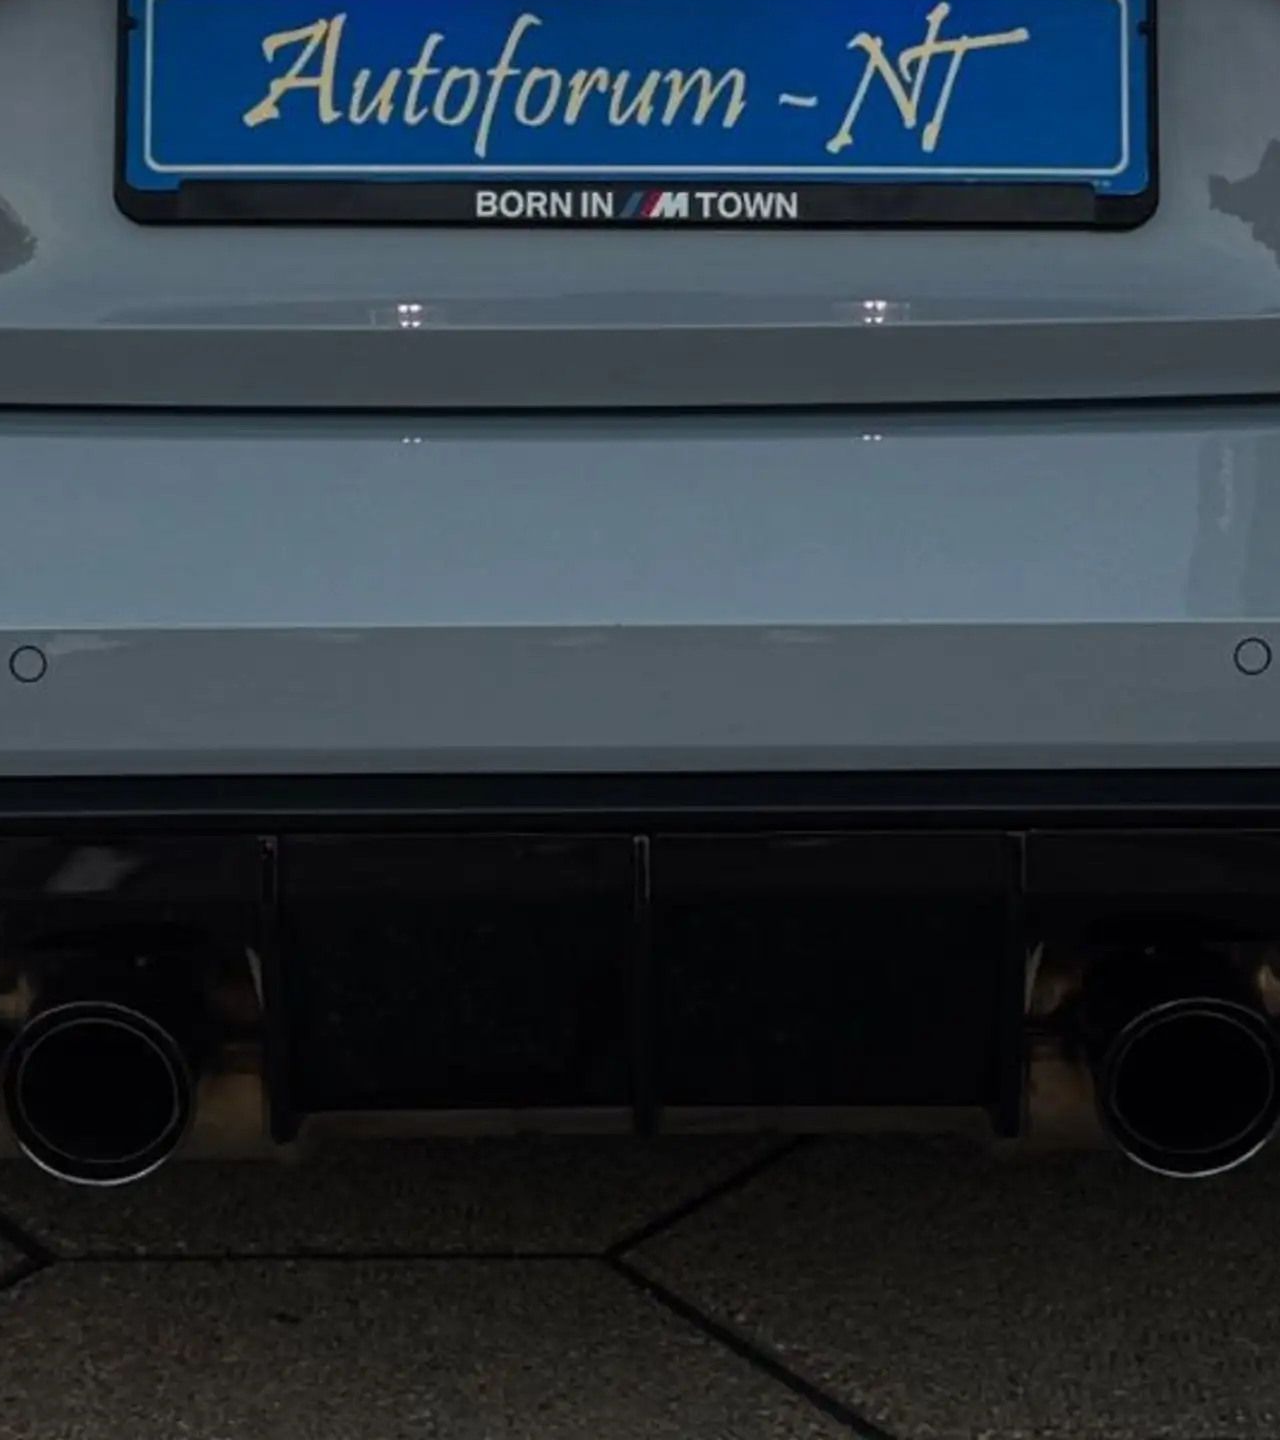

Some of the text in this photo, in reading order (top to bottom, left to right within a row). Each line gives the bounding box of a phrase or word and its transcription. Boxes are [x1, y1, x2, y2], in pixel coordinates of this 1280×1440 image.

[243, 13, 748, 158] Autoforum
[827, 1, 1031, 154] NT
[475, 191, 572, 217] BORN
[581, 191, 614, 217] IN
[695, 191, 798, 217] TOWN
